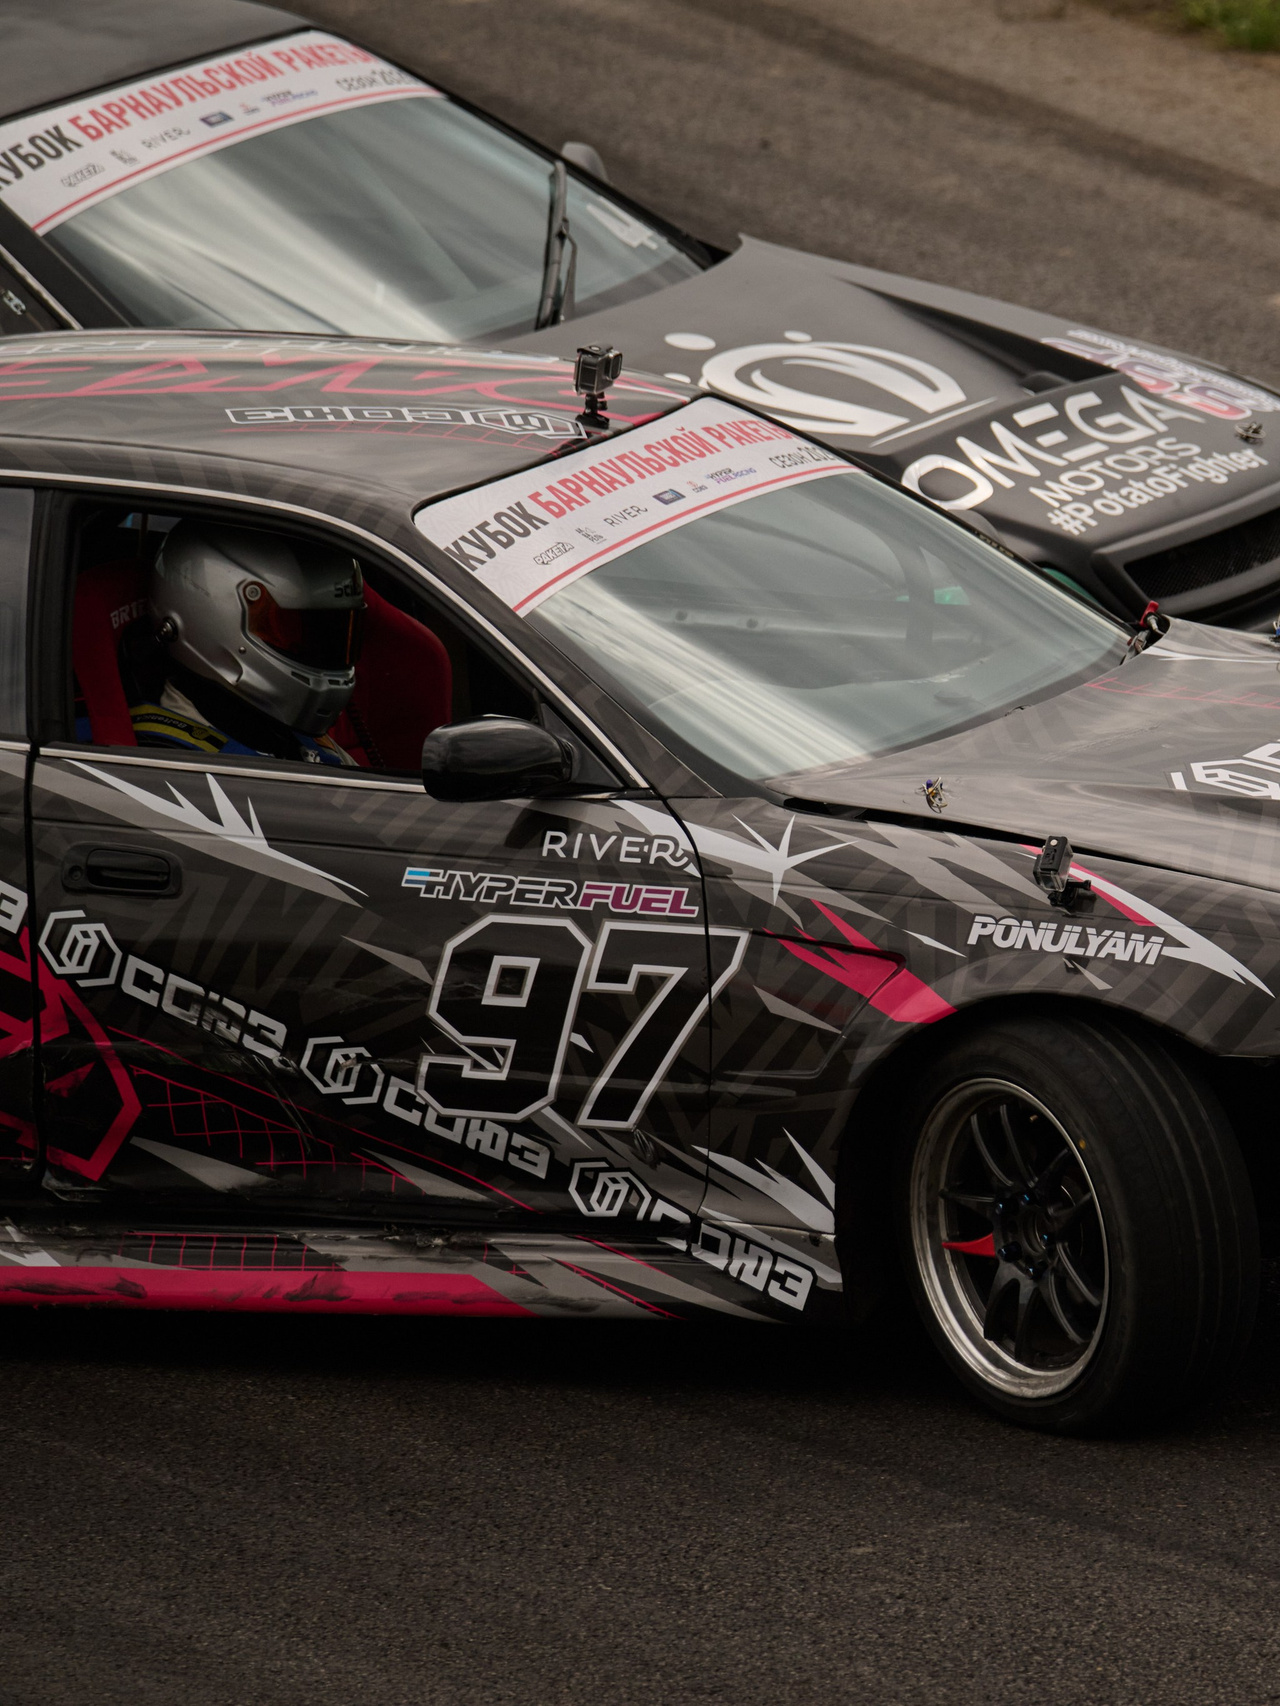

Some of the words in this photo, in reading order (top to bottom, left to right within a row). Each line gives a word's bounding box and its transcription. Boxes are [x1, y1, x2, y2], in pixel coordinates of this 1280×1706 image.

[68, 51, 285, 142] БАРНАУЛЬСКОЙ
[901, 386, 1206, 511] OMEGA
[1029, 437, 1202, 508] MOTORS
[1048, 448, 1269, 535] #PotatoFighter
[444, 501, 550, 572] КУБОК
[527, 426, 721, 519] БАРНАУЛЬСКОЙ
[603, 505, 648, 527] RIVER
[542, 831, 688, 866] RIVER
[967, 915, 1165, 965] PONULYAM
[415, 913, 751, 1131] 97
